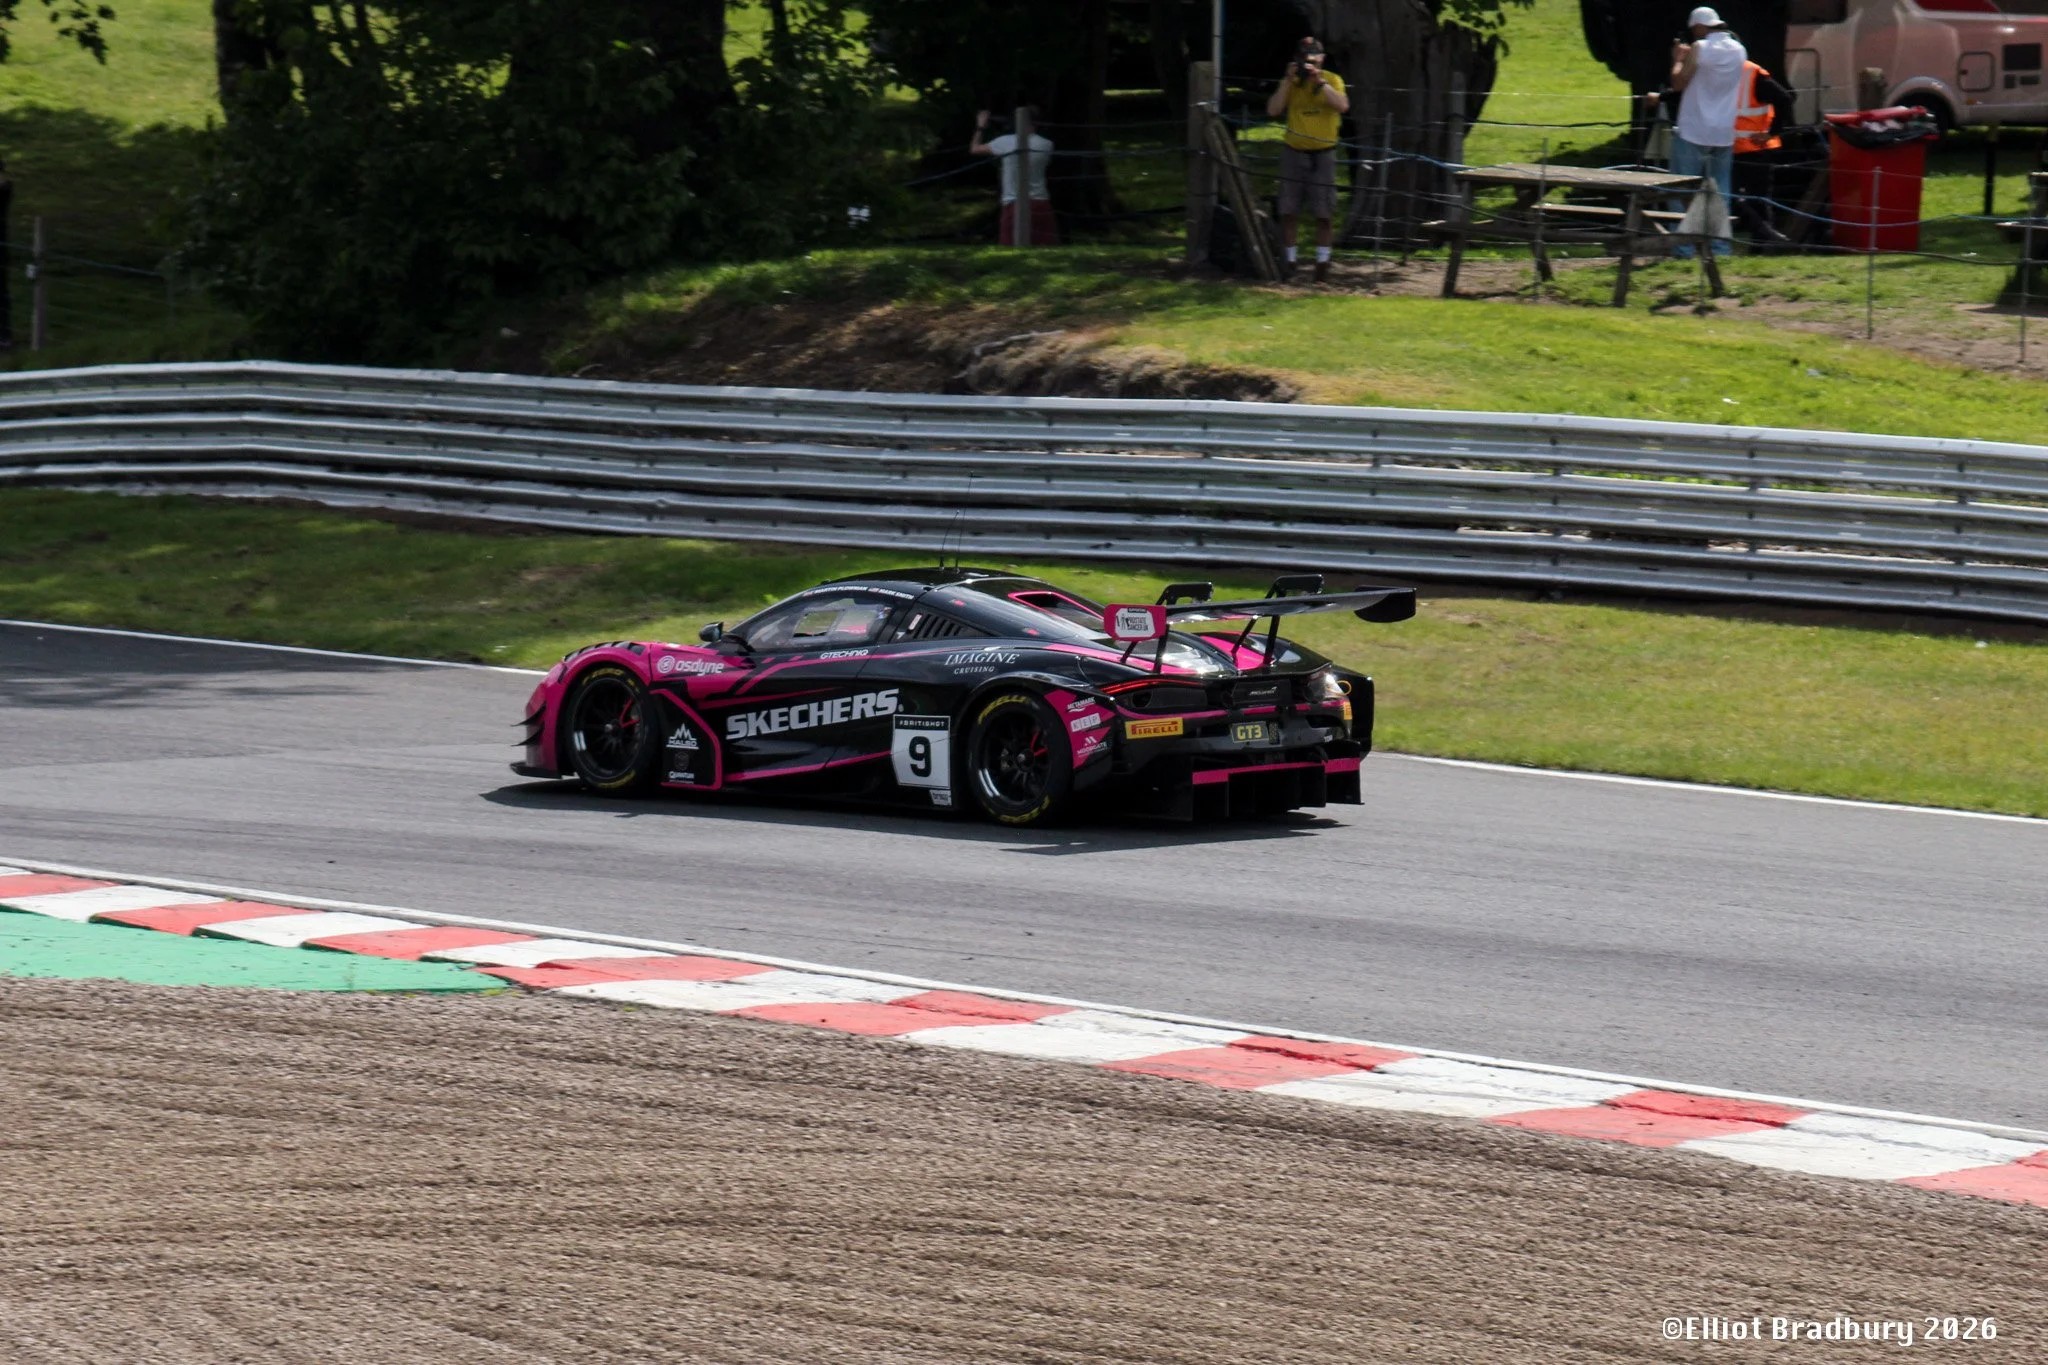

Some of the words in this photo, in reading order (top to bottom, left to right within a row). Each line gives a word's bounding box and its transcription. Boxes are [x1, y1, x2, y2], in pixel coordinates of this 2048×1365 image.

[820, 649, 868, 660] GTECHNIQ
[944, 652, 1020, 666] IMAGINE
[675, 658, 724, 676] osdyne
[953, 666, 996, 675] CRUISING
[725, 688, 899, 740] SKECHERS
[1131, 721, 1178, 735] PIRELLI
[1236, 725, 1263, 740] GT3
[909, 735, 932, 778] 9
